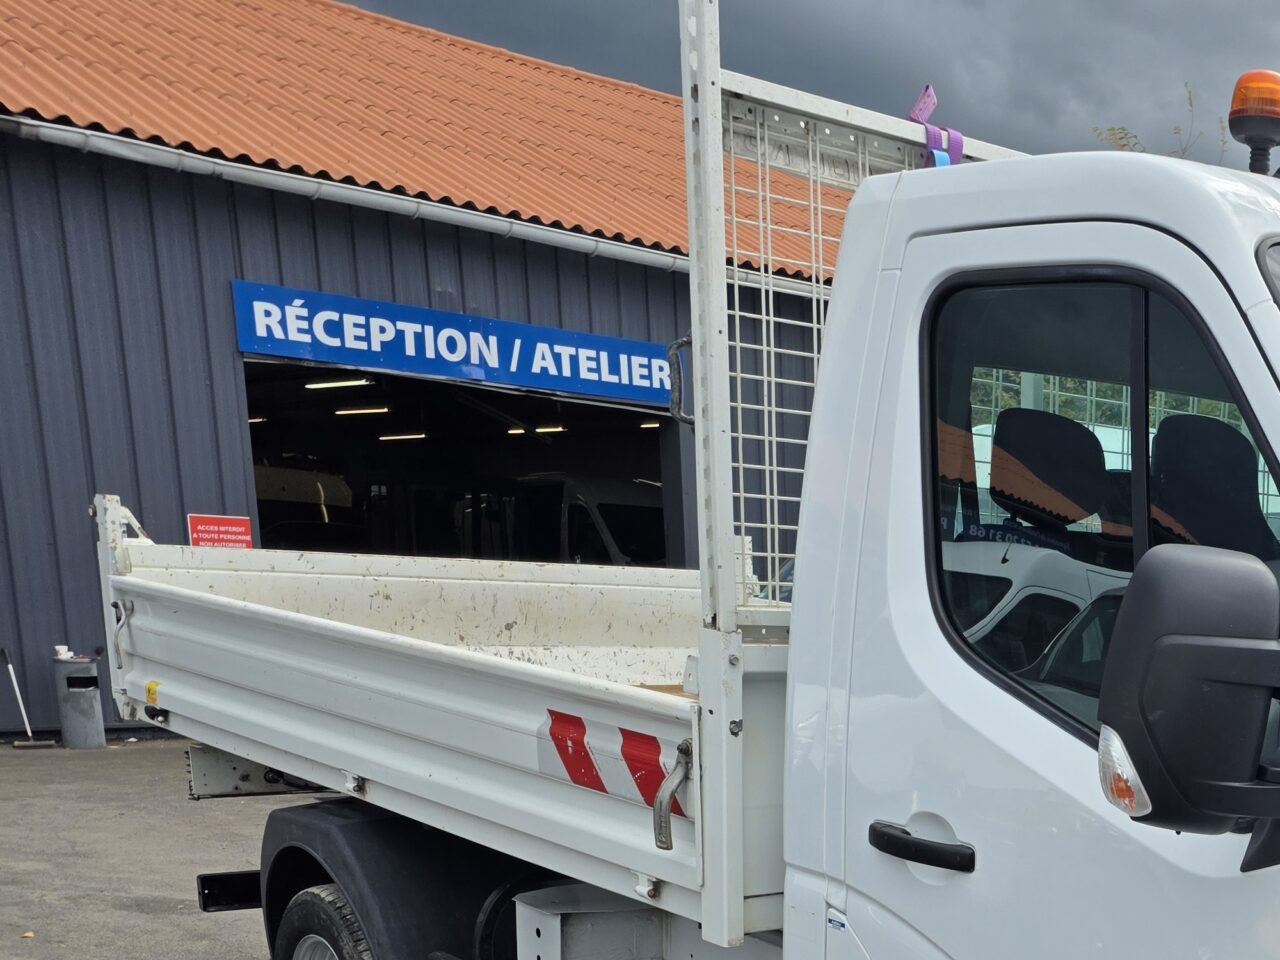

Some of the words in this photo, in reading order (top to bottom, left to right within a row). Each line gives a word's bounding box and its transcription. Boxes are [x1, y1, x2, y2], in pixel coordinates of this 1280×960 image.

[253, 299, 499, 368] RÉCEPTION
[510, 338, 521, 372] /
[531, 342, 671, 390] ATELIER
